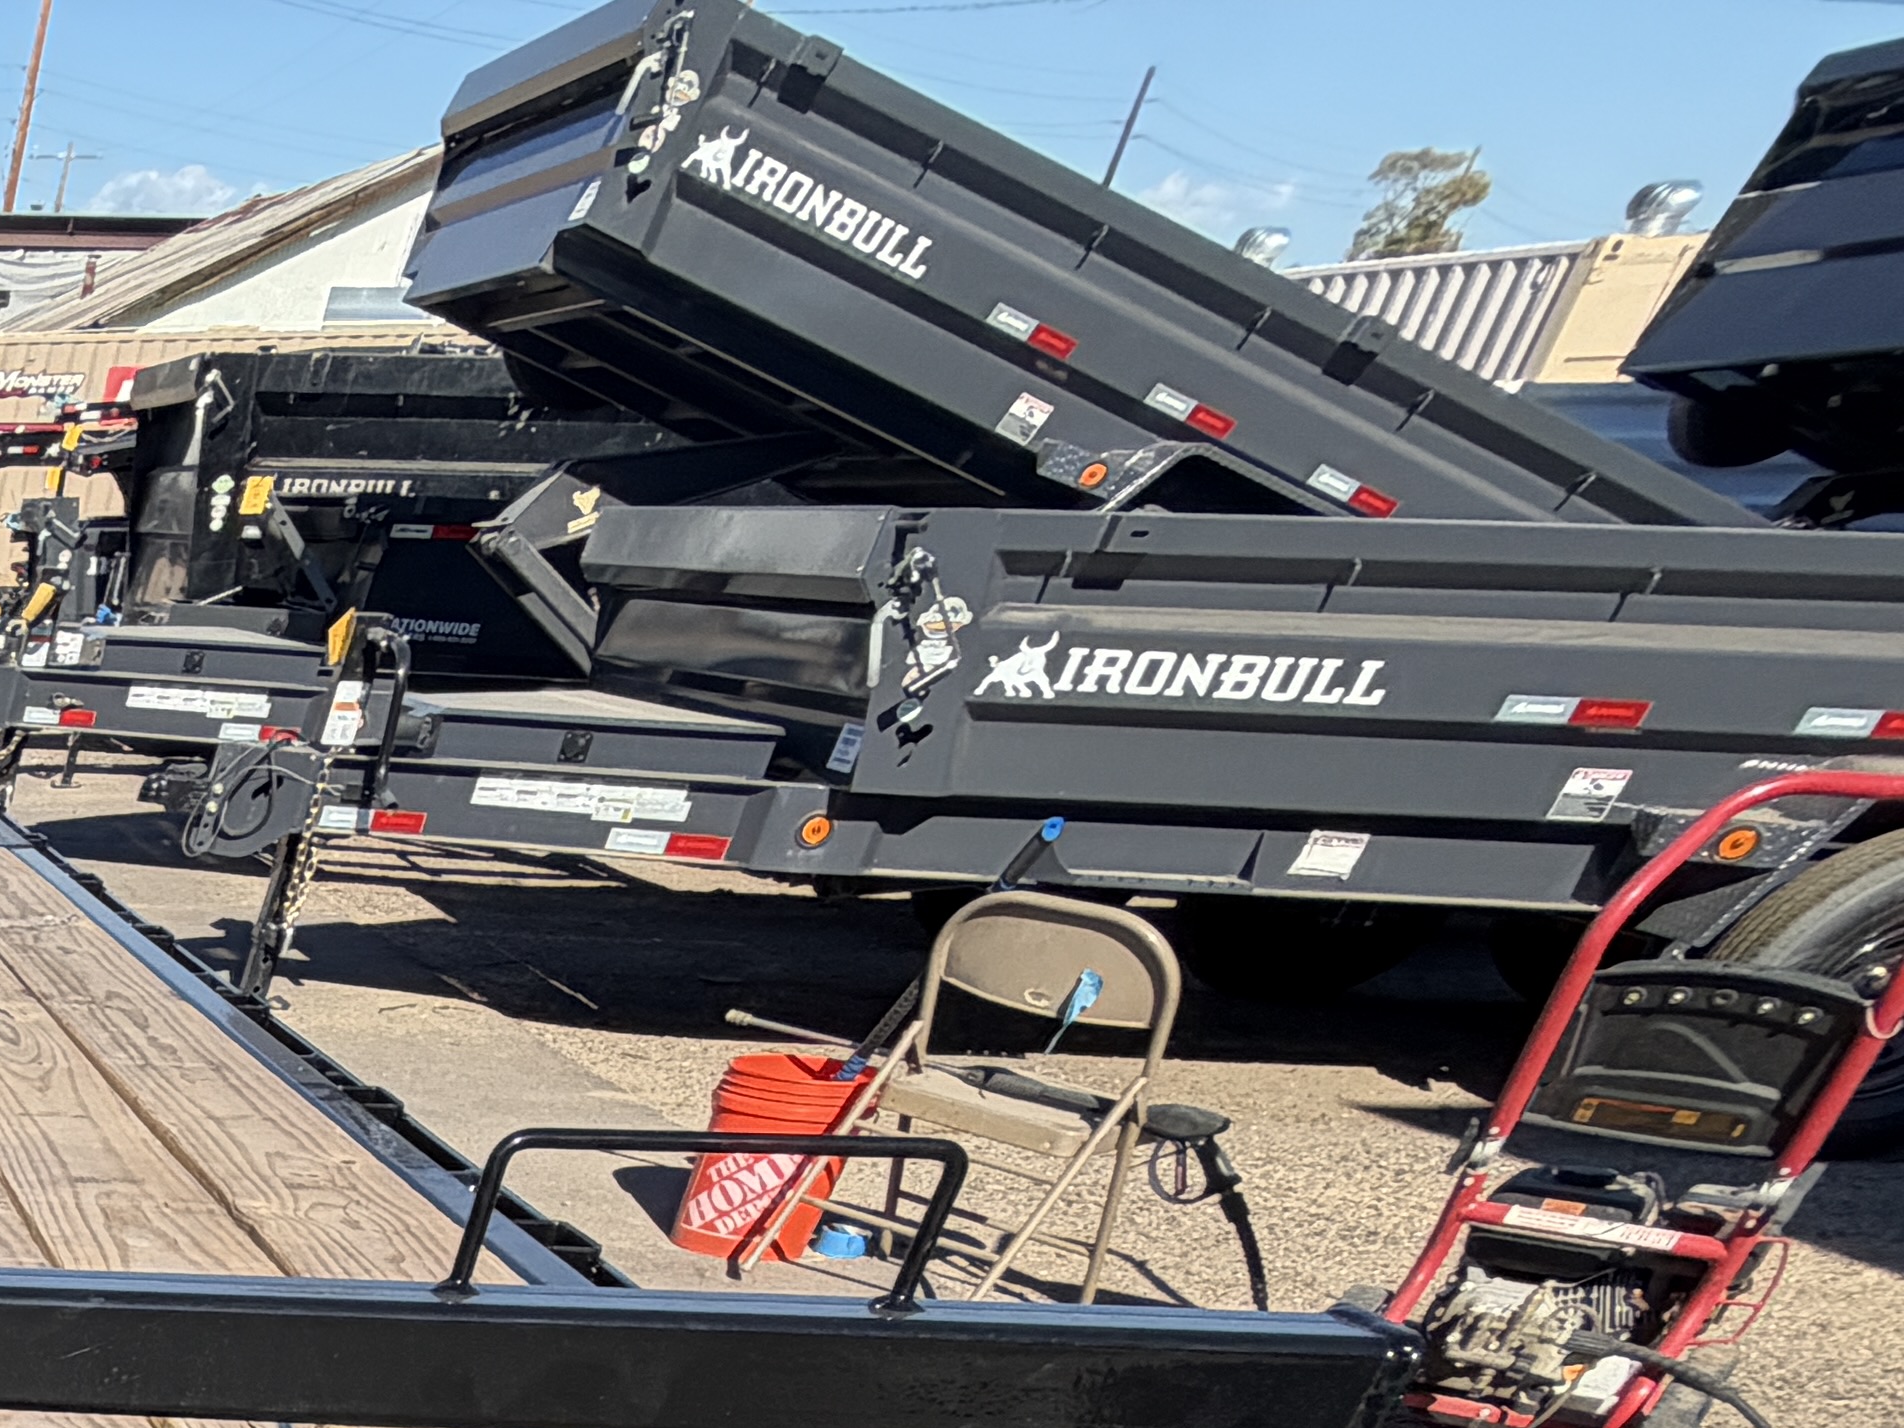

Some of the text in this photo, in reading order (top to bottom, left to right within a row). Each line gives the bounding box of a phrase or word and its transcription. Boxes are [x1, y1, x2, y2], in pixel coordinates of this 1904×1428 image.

[730, 148, 933, 280] IRONBULL
[390, 617, 481, 637] ATIONWIDE
[1052, 647, 1386, 706] IRONBULL
